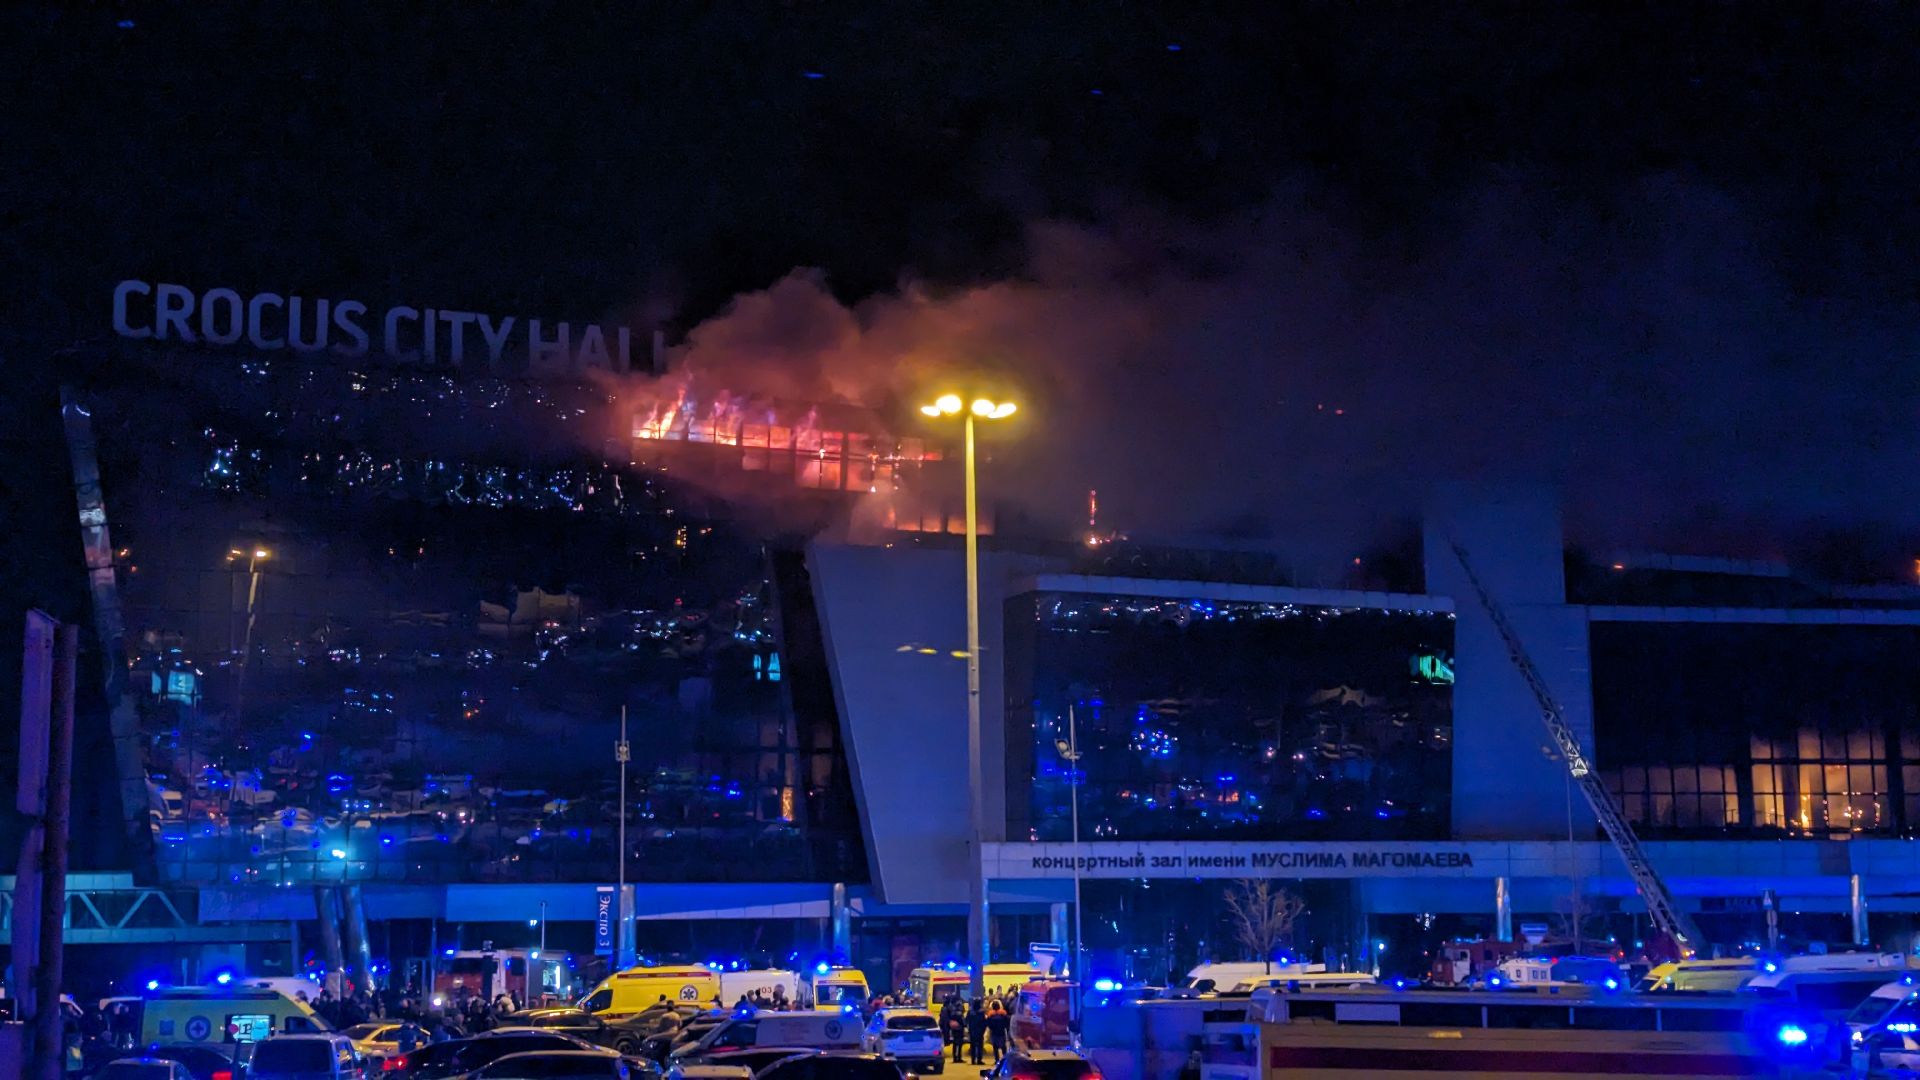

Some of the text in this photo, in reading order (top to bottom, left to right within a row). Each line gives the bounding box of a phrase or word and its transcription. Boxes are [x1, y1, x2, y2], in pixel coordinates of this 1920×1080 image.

[112, 279, 370, 355] CROCUS
[385, 305, 516, 369] CITY
[1032, 852, 1473, 871] концертный зал имени МУСЛИМА МАГОМАЕВА
